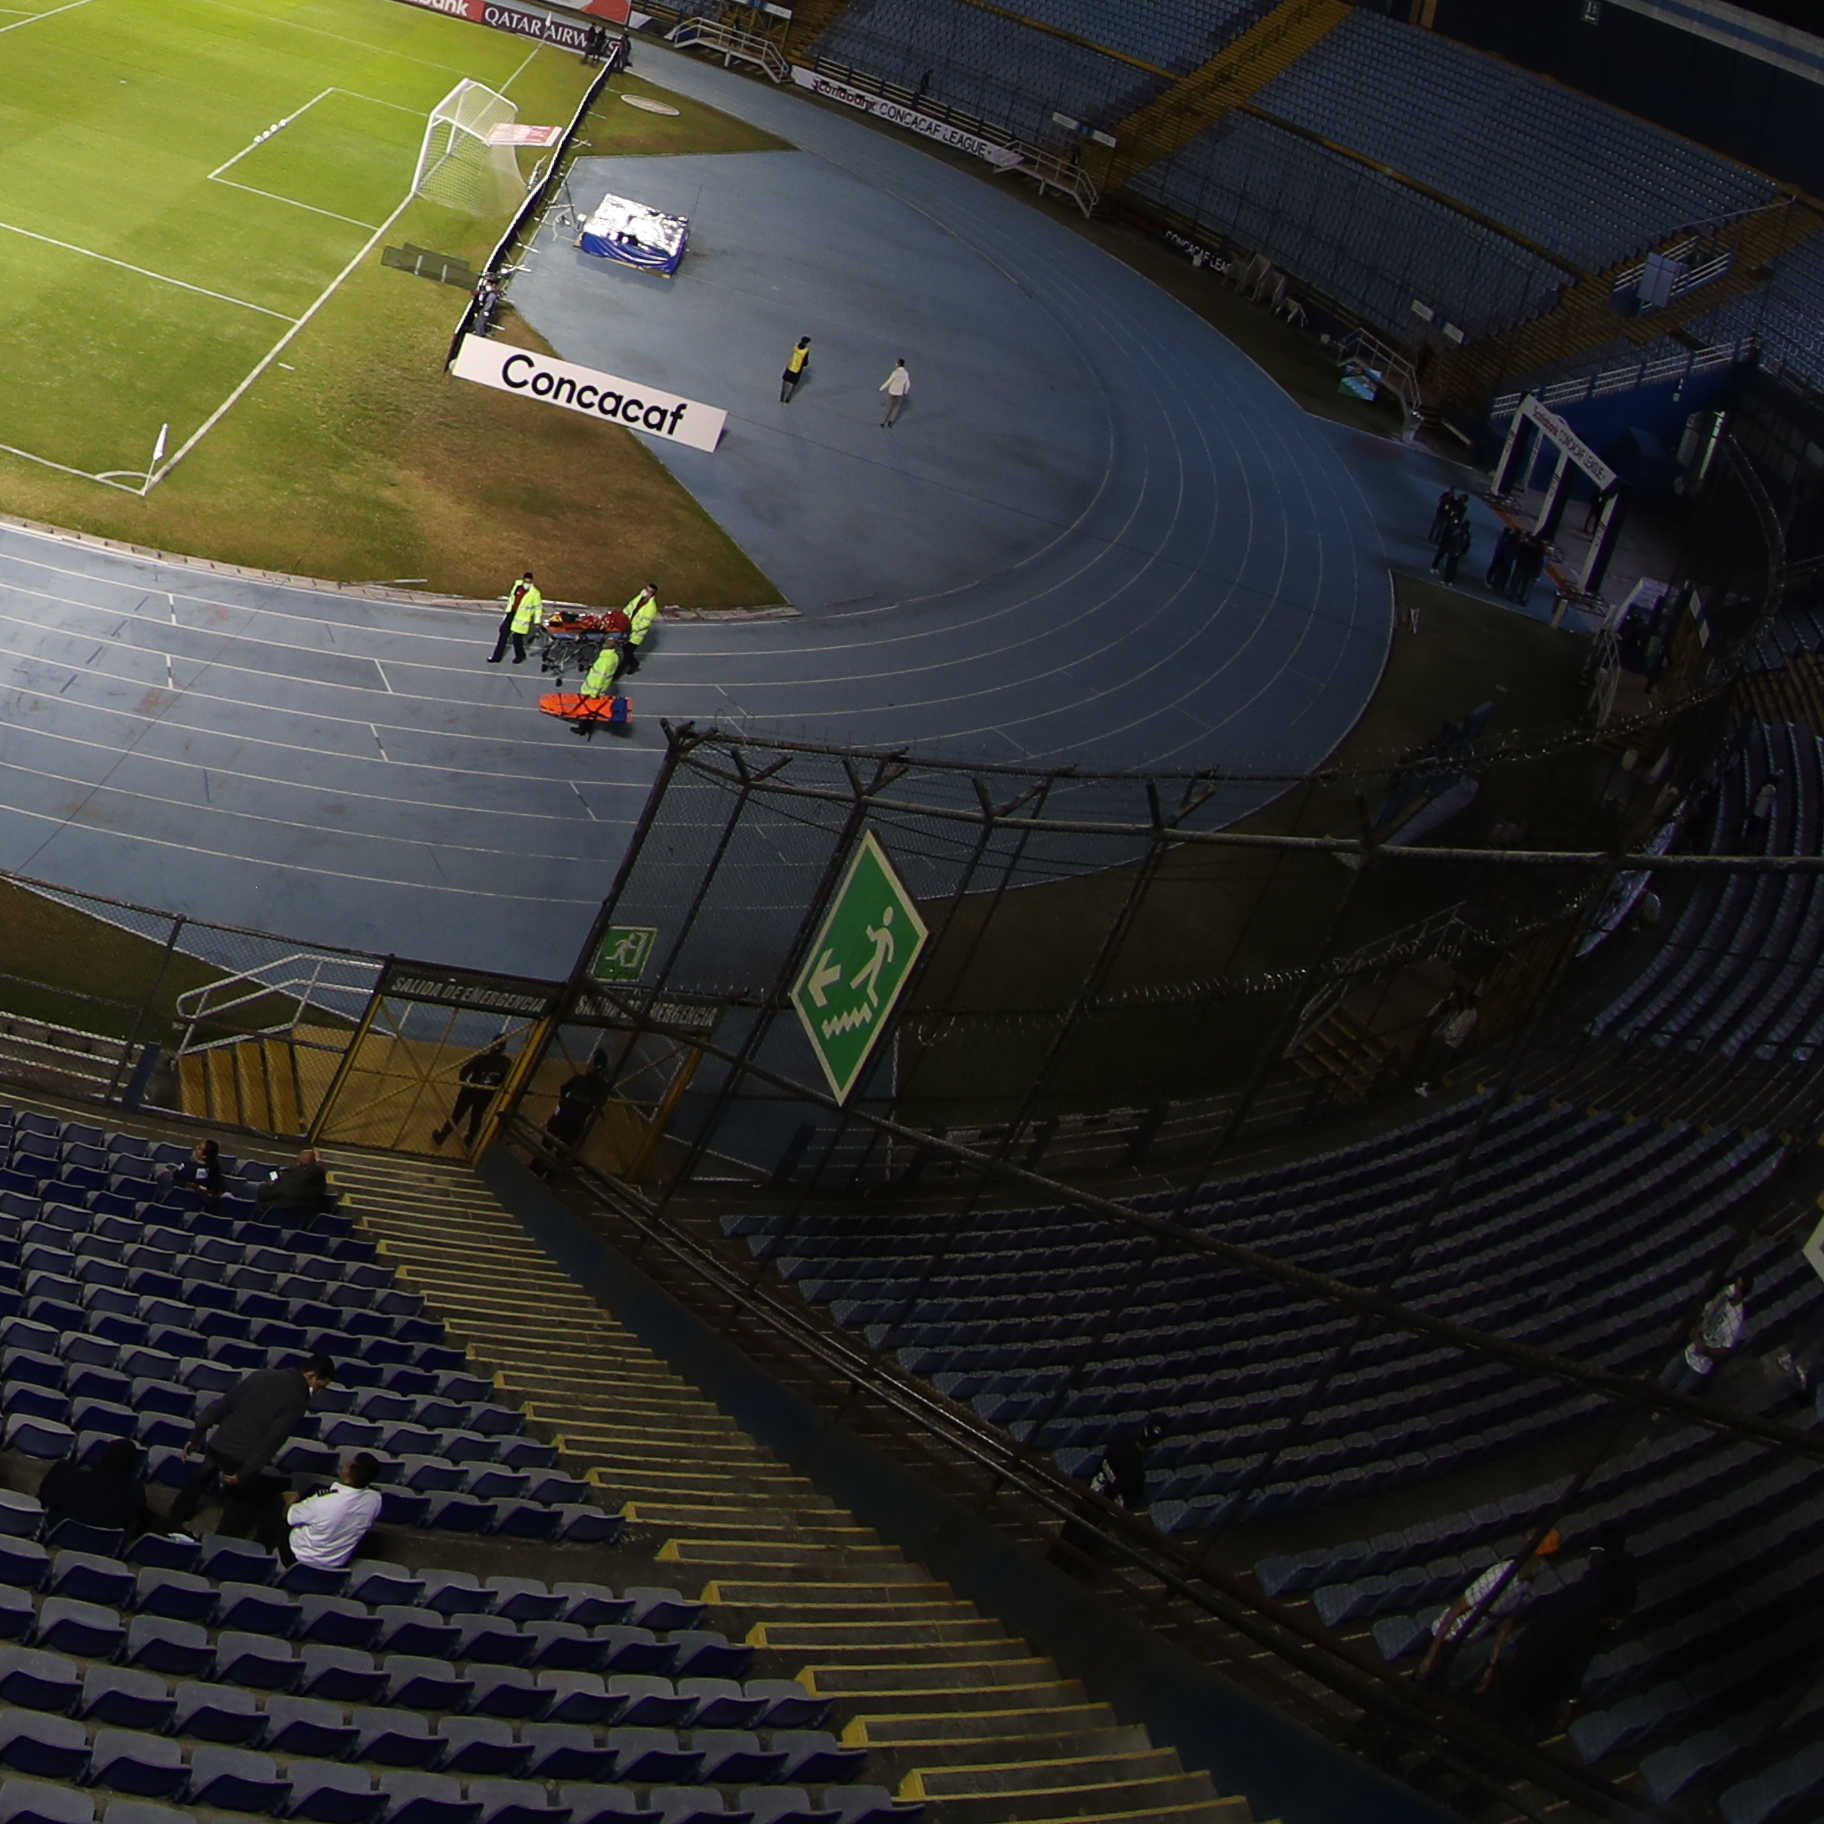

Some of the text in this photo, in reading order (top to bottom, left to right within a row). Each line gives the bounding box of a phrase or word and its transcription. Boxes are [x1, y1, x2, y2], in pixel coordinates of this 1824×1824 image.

[484, 6, 542, 36] QATAR
[879, 102, 942, 139] CONCACAF
[942, 126, 988, 157] LEAGUE
[501, 353, 687, 436] Concacaf
[390, 975, 547, 1013] SALIDA DE EMERGENCIA
